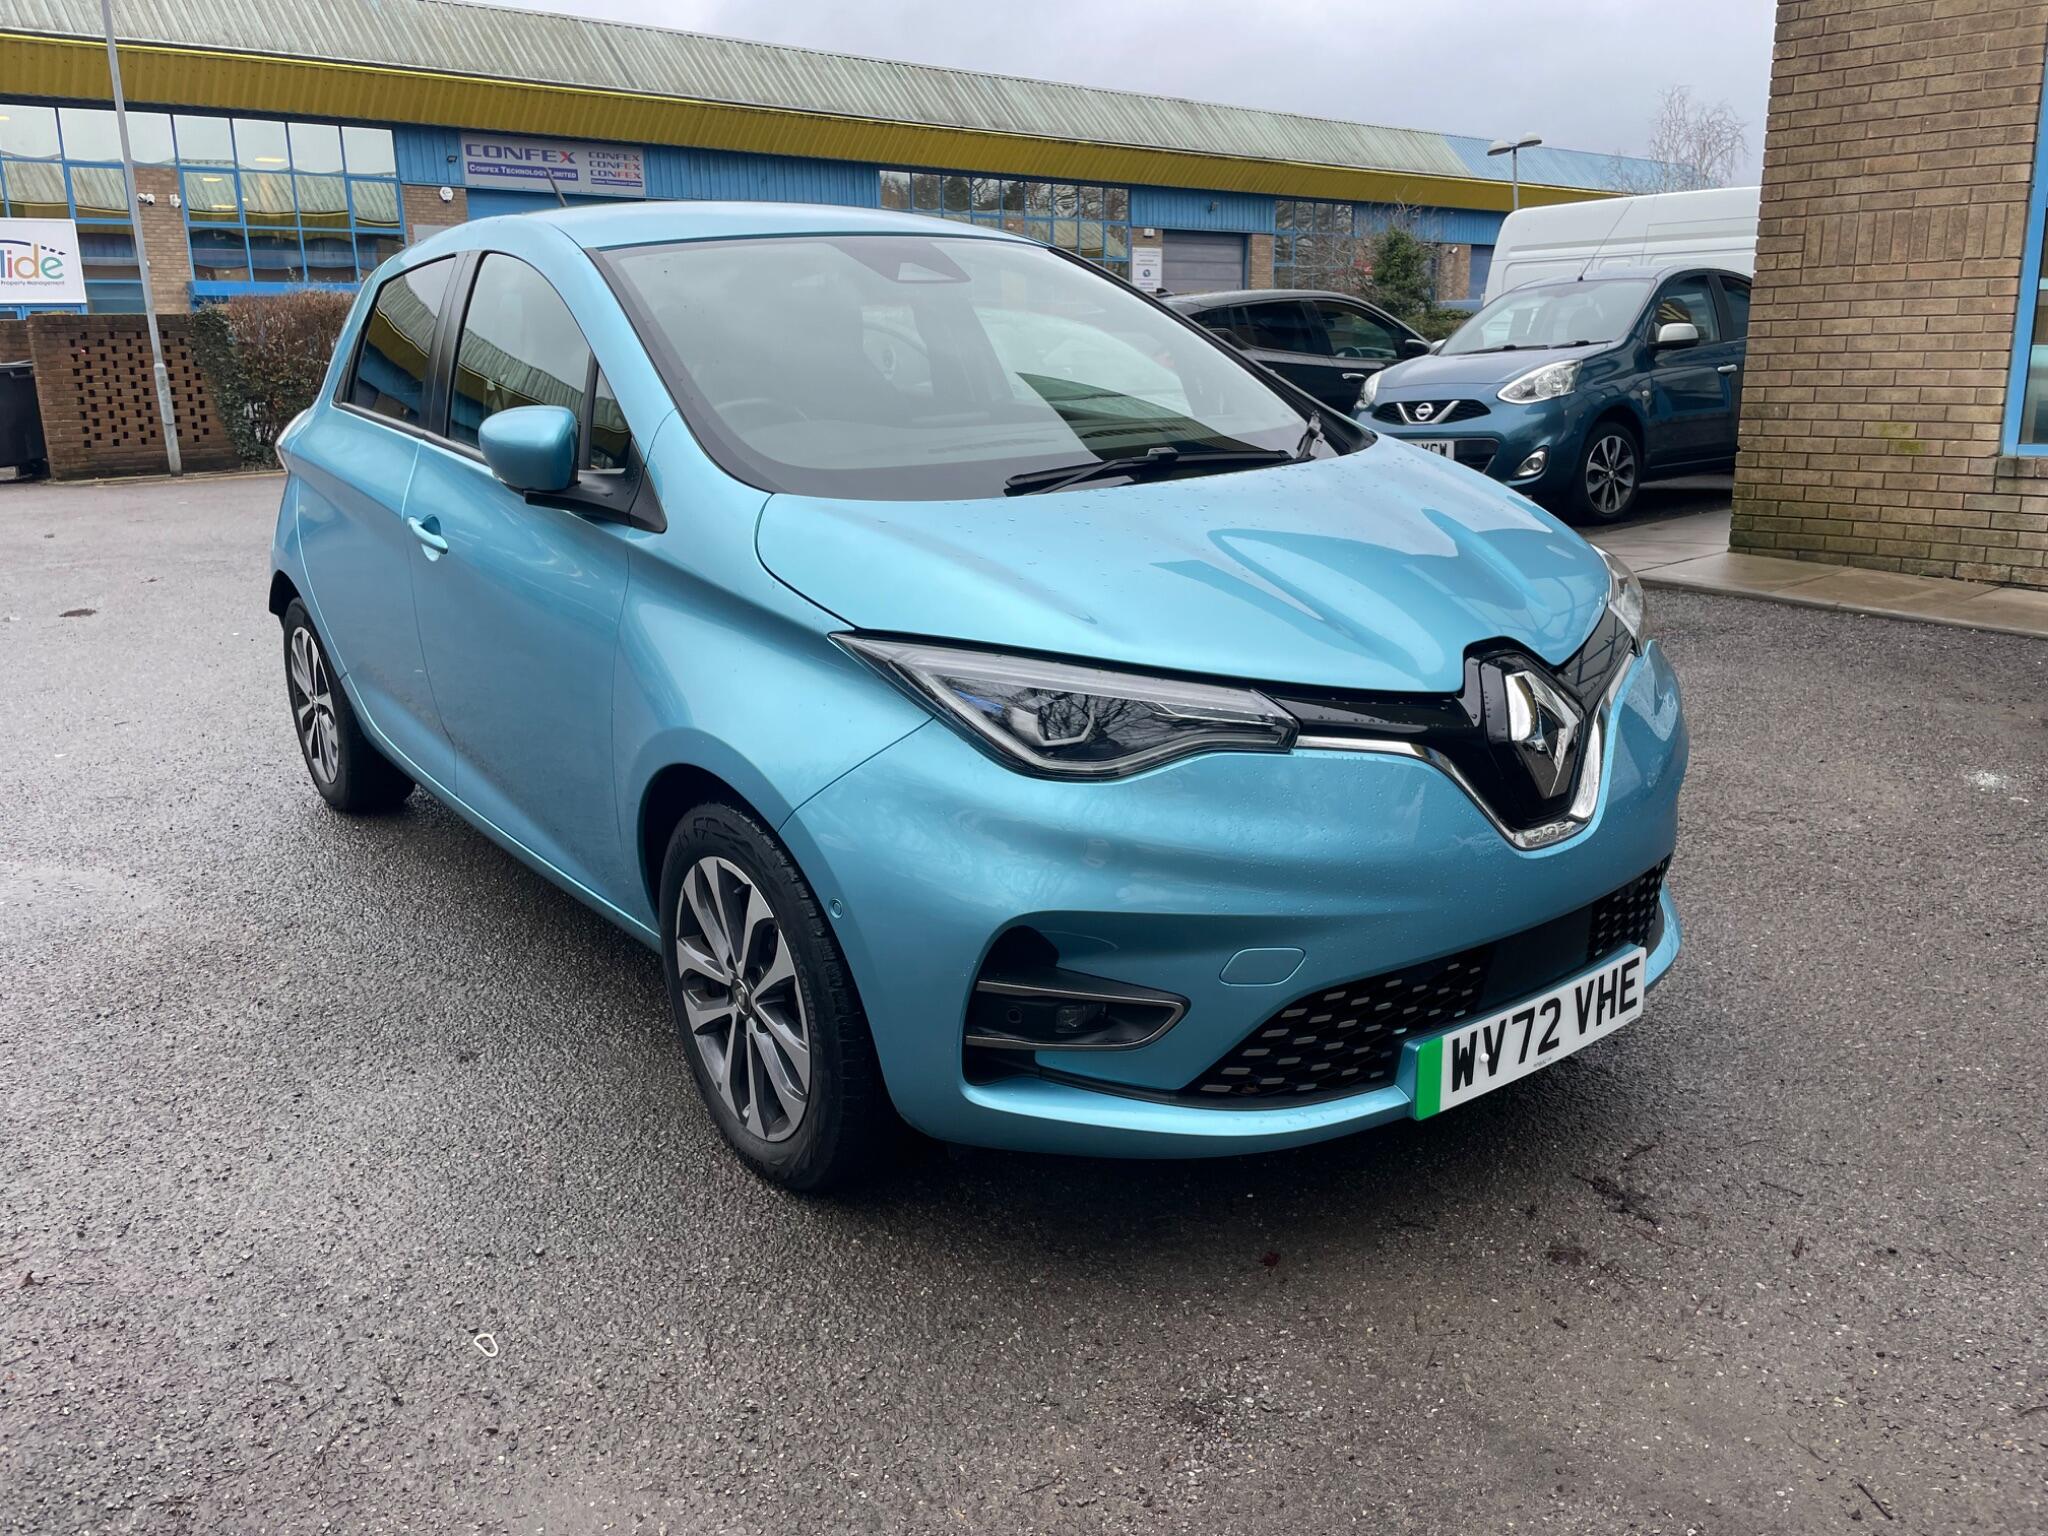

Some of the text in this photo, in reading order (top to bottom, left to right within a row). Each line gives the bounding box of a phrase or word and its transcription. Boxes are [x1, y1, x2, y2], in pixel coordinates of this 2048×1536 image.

[465, 143, 577, 164] CONFEX
[588, 151, 640, 161] CONFEX
[469, 164, 499, 174] CONFEX
[589, 160, 641, 170] CONFEX
[590, 169, 641, 179] CONFEX
[1451, 956, 1640, 1093] WV72 VHE
